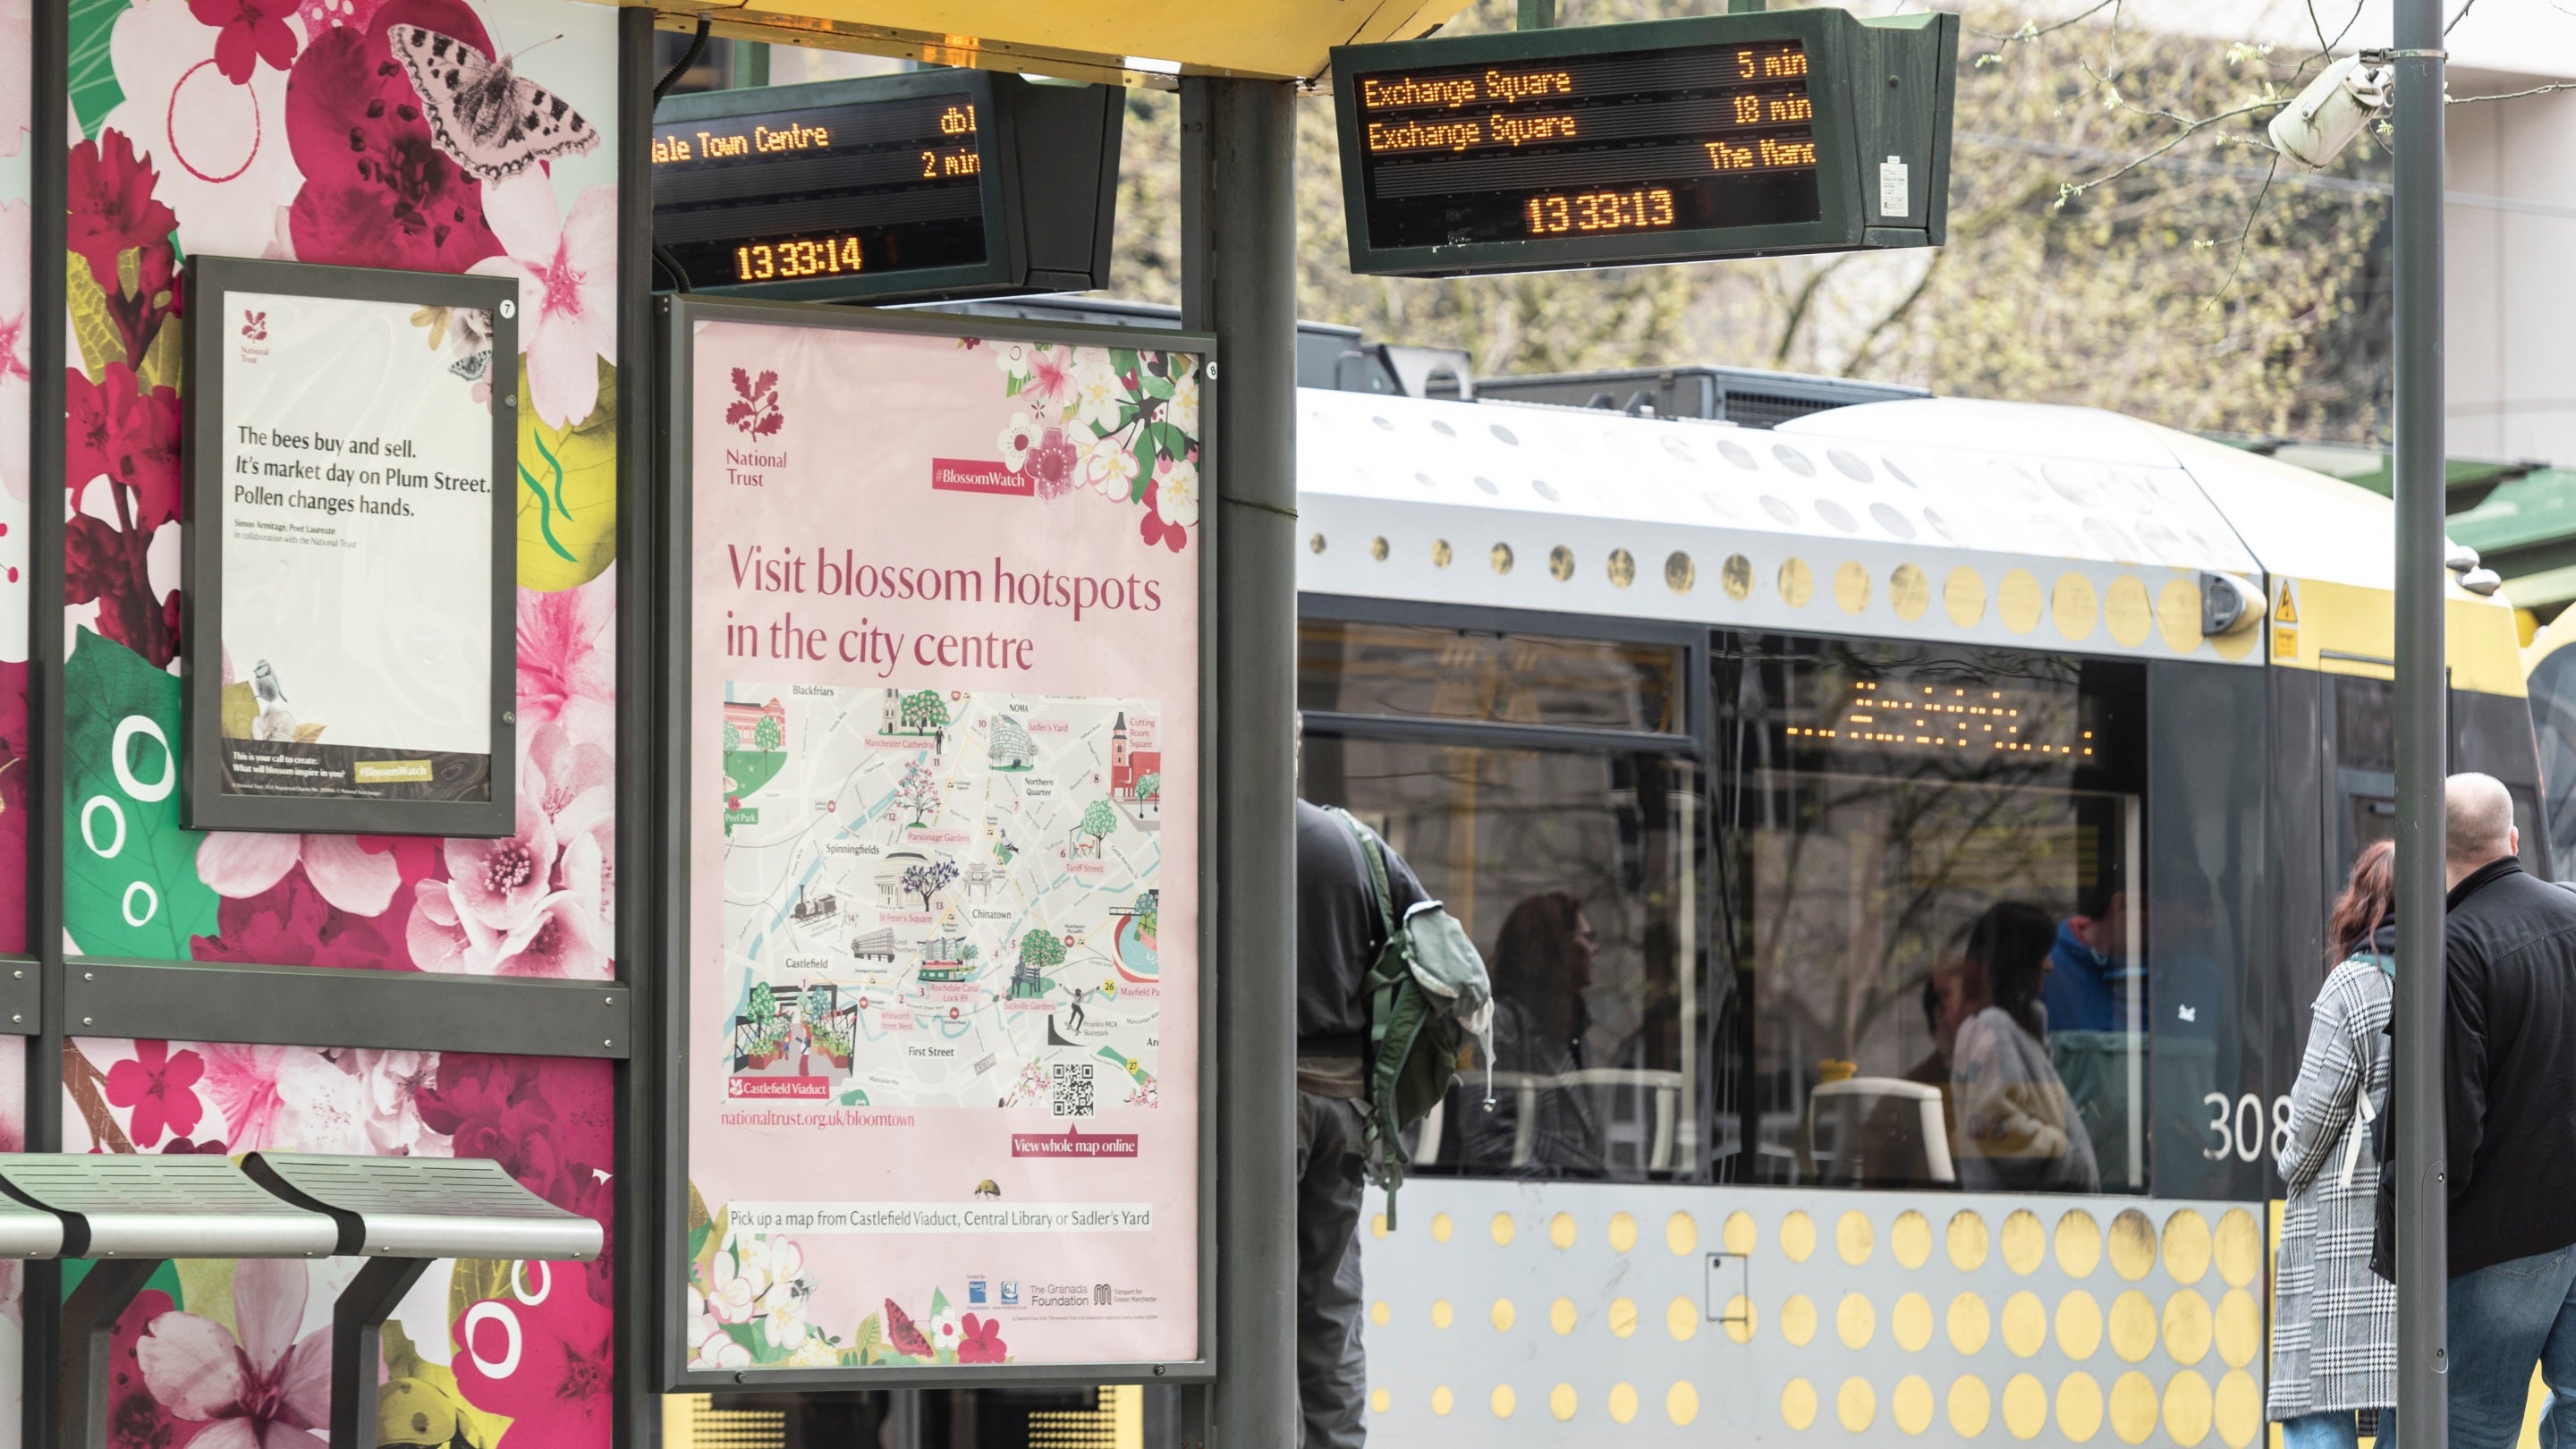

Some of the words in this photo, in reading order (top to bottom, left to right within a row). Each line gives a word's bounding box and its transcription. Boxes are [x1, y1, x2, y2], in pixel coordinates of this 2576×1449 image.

[1364, 77, 1476, 109] Exchange
[1485, 71, 1572, 105] Square
[1738, 51, 1753, 79] 5
[1765, 46, 1808, 76] min
[1368, 119, 1480, 151] Exchange
[1490, 114, 1576, 148] Square
[1733, 96, 1759, 124] 18
[1771, 94, 1812, 123] min
[697, 131, 748, 157] Town
[756, 124, 828, 152] Centre
[1706, 143, 1754, 170] The
[923, 153, 936, 177] 2
[945, 150, 980, 175] min
[505, 304, 511, 315] 7
[241, 345, 268, 357] National
[242, 354, 258, 364] Trust
[1210, 366, 1216, 376] 8
[237, 426, 267, 446] The
[271, 429, 309, 450] bees
[314, 432, 344, 457] buy
[349, 436, 379, 456] and
[385, 439, 417, 459] sell.
[726, 449, 787, 470] National
[264, 459, 321, 481] market
[326, 462, 355, 487] day
[359, 470, 380, 486] on
[386, 468, 428, 489] Plum
[434, 471, 491, 494] Street.
[727, 469, 764, 487] Trust
[936, 469, 1025, 489] #BlossomWatch
[234, 485, 284, 507] Pollen
[288, 489, 355, 516] changes
[360, 495, 415, 517] hands.
[234, 518, 255, 529] Simon
[257, 521, 288, 532] Armitage,
[289, 523, 305, 533] Poet
[306, 525, 336, 536] Laureate
[242, 531, 283, 543] collaboration
[284, 537, 298, 545] with
[299, 537, 309, 545] the
[310, 538, 338, 547] National
[340, 539, 357, 548] Trust
[727, 543, 807, 595] Visit
[818, 547, 983, 604] blossom
[994, 556, 1162, 623] hotspots
[726, 610, 758, 658] in
[770, 611, 827, 661] the
[838, 617, 905, 680] city
[913, 631, 1035, 672] centre
[792, 685, 835, 698] Blackfriars
[1009, 703, 1030, 714] NOMA
[979, 720, 987, 728] 10
[1053, 724, 1068, 733] Yard
[1130, 718, 1155, 729] Cutting
[1130, 729, 1150, 738] Room
[865, 739, 902, 749] Manchester
[902, 740, 935, 750] Cathedral
[1130, 740, 1153, 750] Square
[233, 751, 248, 761] This
[249, 752, 255, 761] is
[255, 754, 272, 764] your
[272, 754, 284, 763] call
[285, 755, 293, 763] to
[934, 758, 940, 767] 11
[233, 763, 252, 774] What
[253, 765, 266, 774] will
[266, 765, 294, 775] blossom
[295, 767, 319, 779] inspire
[320, 767, 328, 777] in
[329, 769, 346, 779] you?
[360, 765, 427, 777] #BlossomWatch
[1025, 777, 1054, 786] Northern
[1094, 775, 1099, 784] 8
[1026, 787, 1052, 797] Quarter
[725, 813, 739, 822] Peel
[741, 813, 756, 823] Park
[888, 813, 896, 821] 12
[908, 832, 943, 843] Parsonage
[945, 833, 970, 843] Gardens
[826, 843, 880, 856] Spinningfields
[1060, 849, 1066, 858] 6
[1065, 863, 1083, 873] Tariff
[1084, 864, 1104, 874] Street
[936, 902, 944, 911] 13
[848, 914, 855, 923] 14
[879, 912, 886, 921] St
[908, 914, 932, 923] Square
[972, 909, 1012, 919] Chinatown
[1012, 940, 1016, 949] 5
[995, 950, 999, 959] 4
[785, 958, 828, 969] Castlefield
[919, 987, 925, 997] 3
[931, 984, 962, 992] Rochdale
[962, 985, 980, 993] Canal
[1105, 982, 1114, 991] 26
[1121, 987, 1150, 997] Mayfield
[898, 995, 904, 1004] 2
[943, 994, 959, 1003] Lock
[960, 995, 969, 1003] 89
[1004, 1001, 1031, 1011] Sackville
[1031, 1003, 1056, 1012] Gardens
[881, 1012, 911, 1021] Whitworth
[881, 1021, 898, 1030] Street
[898, 1022, 913, 1031] West
[908, 1046, 926, 1057] First
[928, 1046, 954, 1057] Street
[1129, 1062, 1137, 1070] 27
[744, 1081, 791, 1095] Castlefield
[792, 1083, 826, 1096] Viaduct
[721, 1110, 915, 1131] nationaltrust.org.uk/bloomtown
[1014, 1139, 1040, 1152] View
[1041, 1138, 1073, 1152] whole
[1075, 1141, 1100, 1157] map
[1101, 1139, 1136, 1153] online
[731, 1209, 754, 1227] Pick
[757, 1214, 773, 1232] up
[775, 1215, 783, 1227] a
[785, 1214, 814, 1232] map
[818, 1209, 847, 1227] from
[850, 1209, 911, 1228] Castlefield
[913, 1209, 962, 1229] Viaduct,
[964, 1209, 1009, 1228] Central
[1012, 1209, 1053, 1233] Library
[1055, 1214, 1068, 1228] or
[1121, 1209, 1150, 1228] Yard
[1030, 1285, 1046, 1294] The
[1046, 1284, 1088, 1294] Granada
[1113, 1289, 1134, 1297] Transport
[1135, 1288, 1143, 1296] for
[1031, 1295, 1089, 1307] Foundation
[1113, 1296, 1130, 1304] Greater
